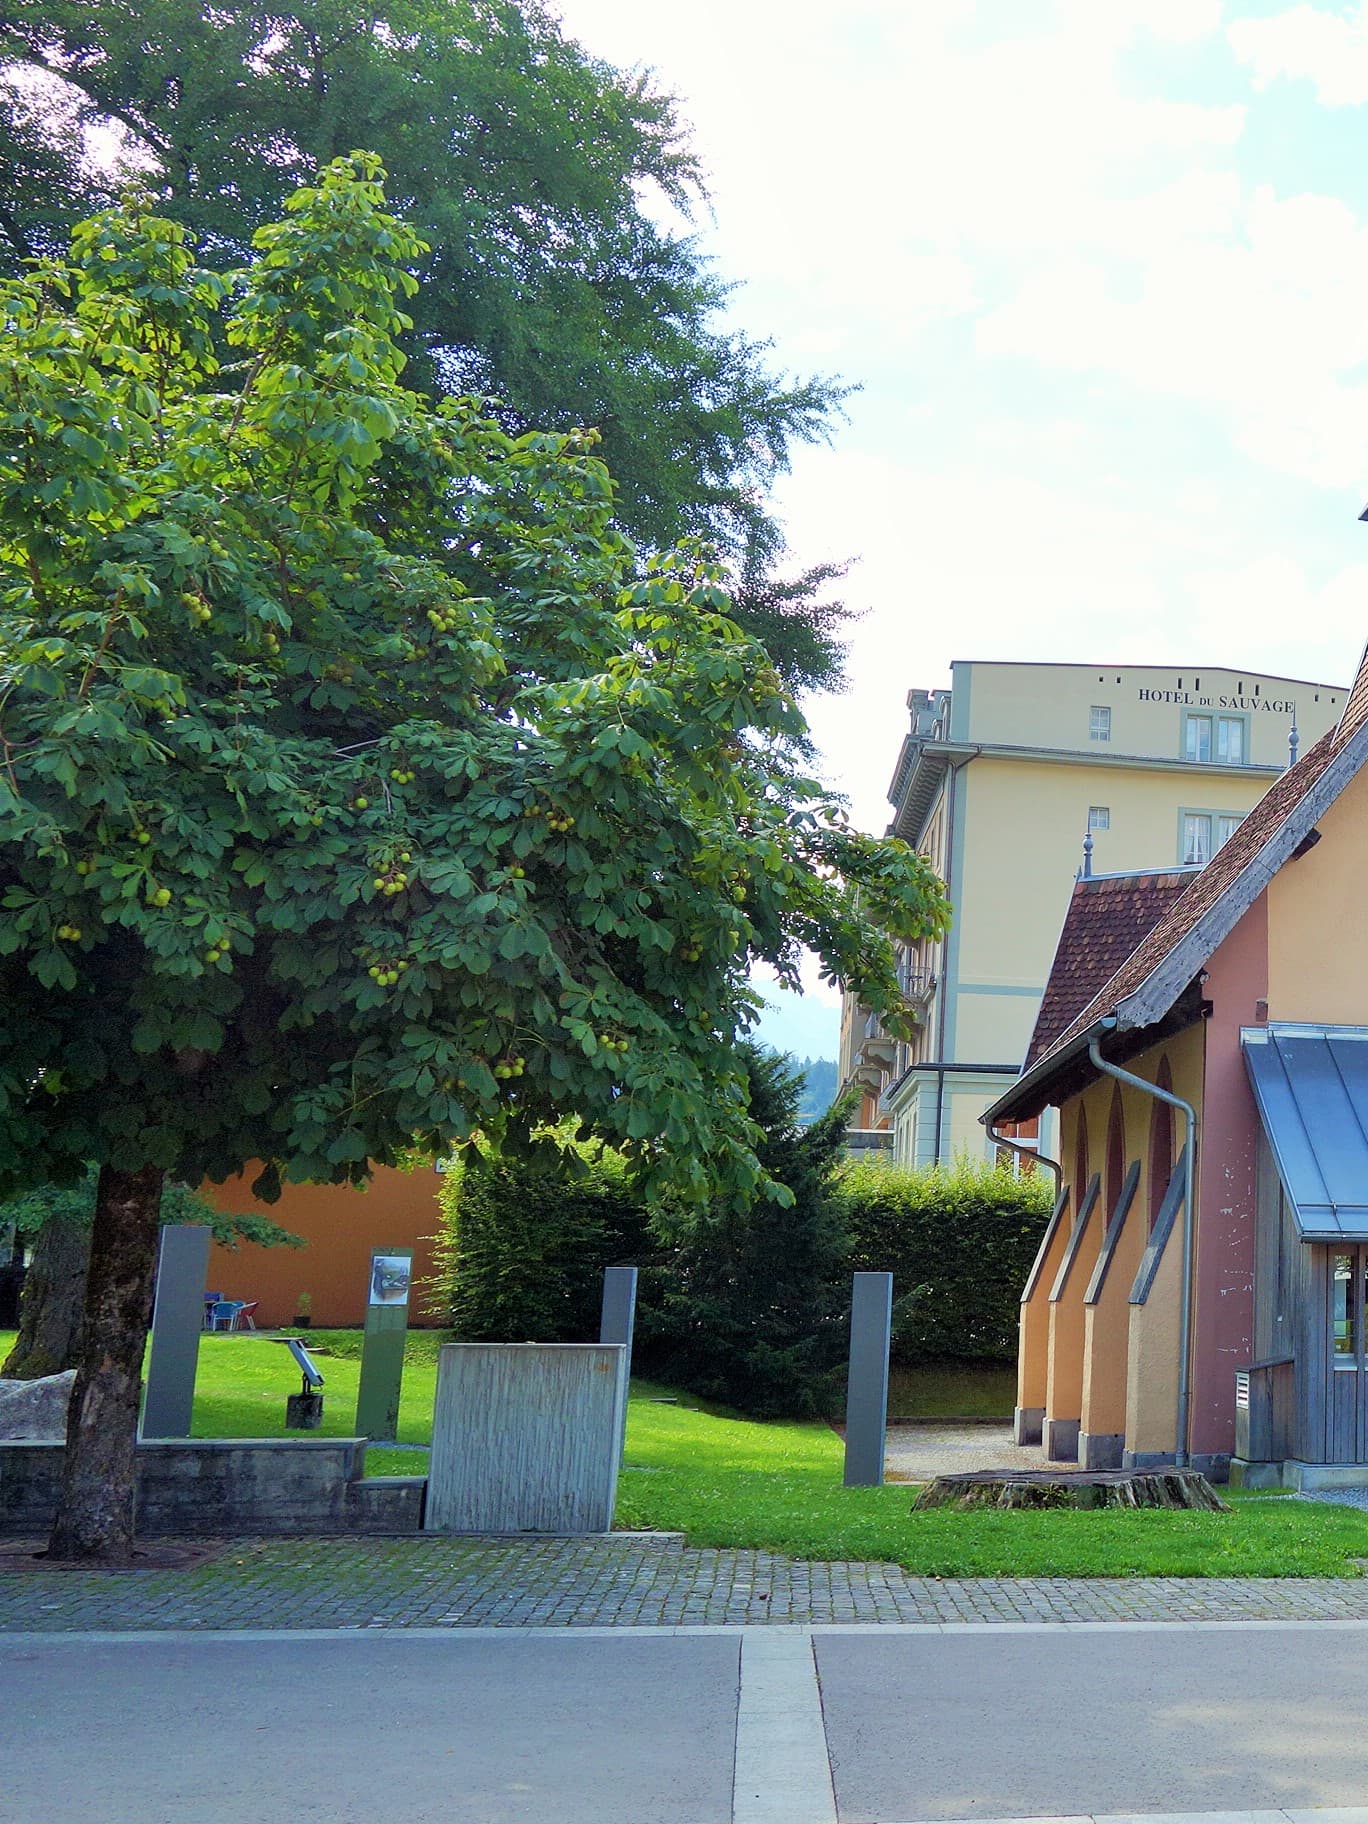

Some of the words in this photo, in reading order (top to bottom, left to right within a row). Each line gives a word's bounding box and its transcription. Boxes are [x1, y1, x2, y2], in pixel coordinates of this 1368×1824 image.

[1138, 688, 1194, 705] HOTEL
[1199, 697, 1214, 706] DU
[1219, 695, 1294, 714] SAUVAGE
